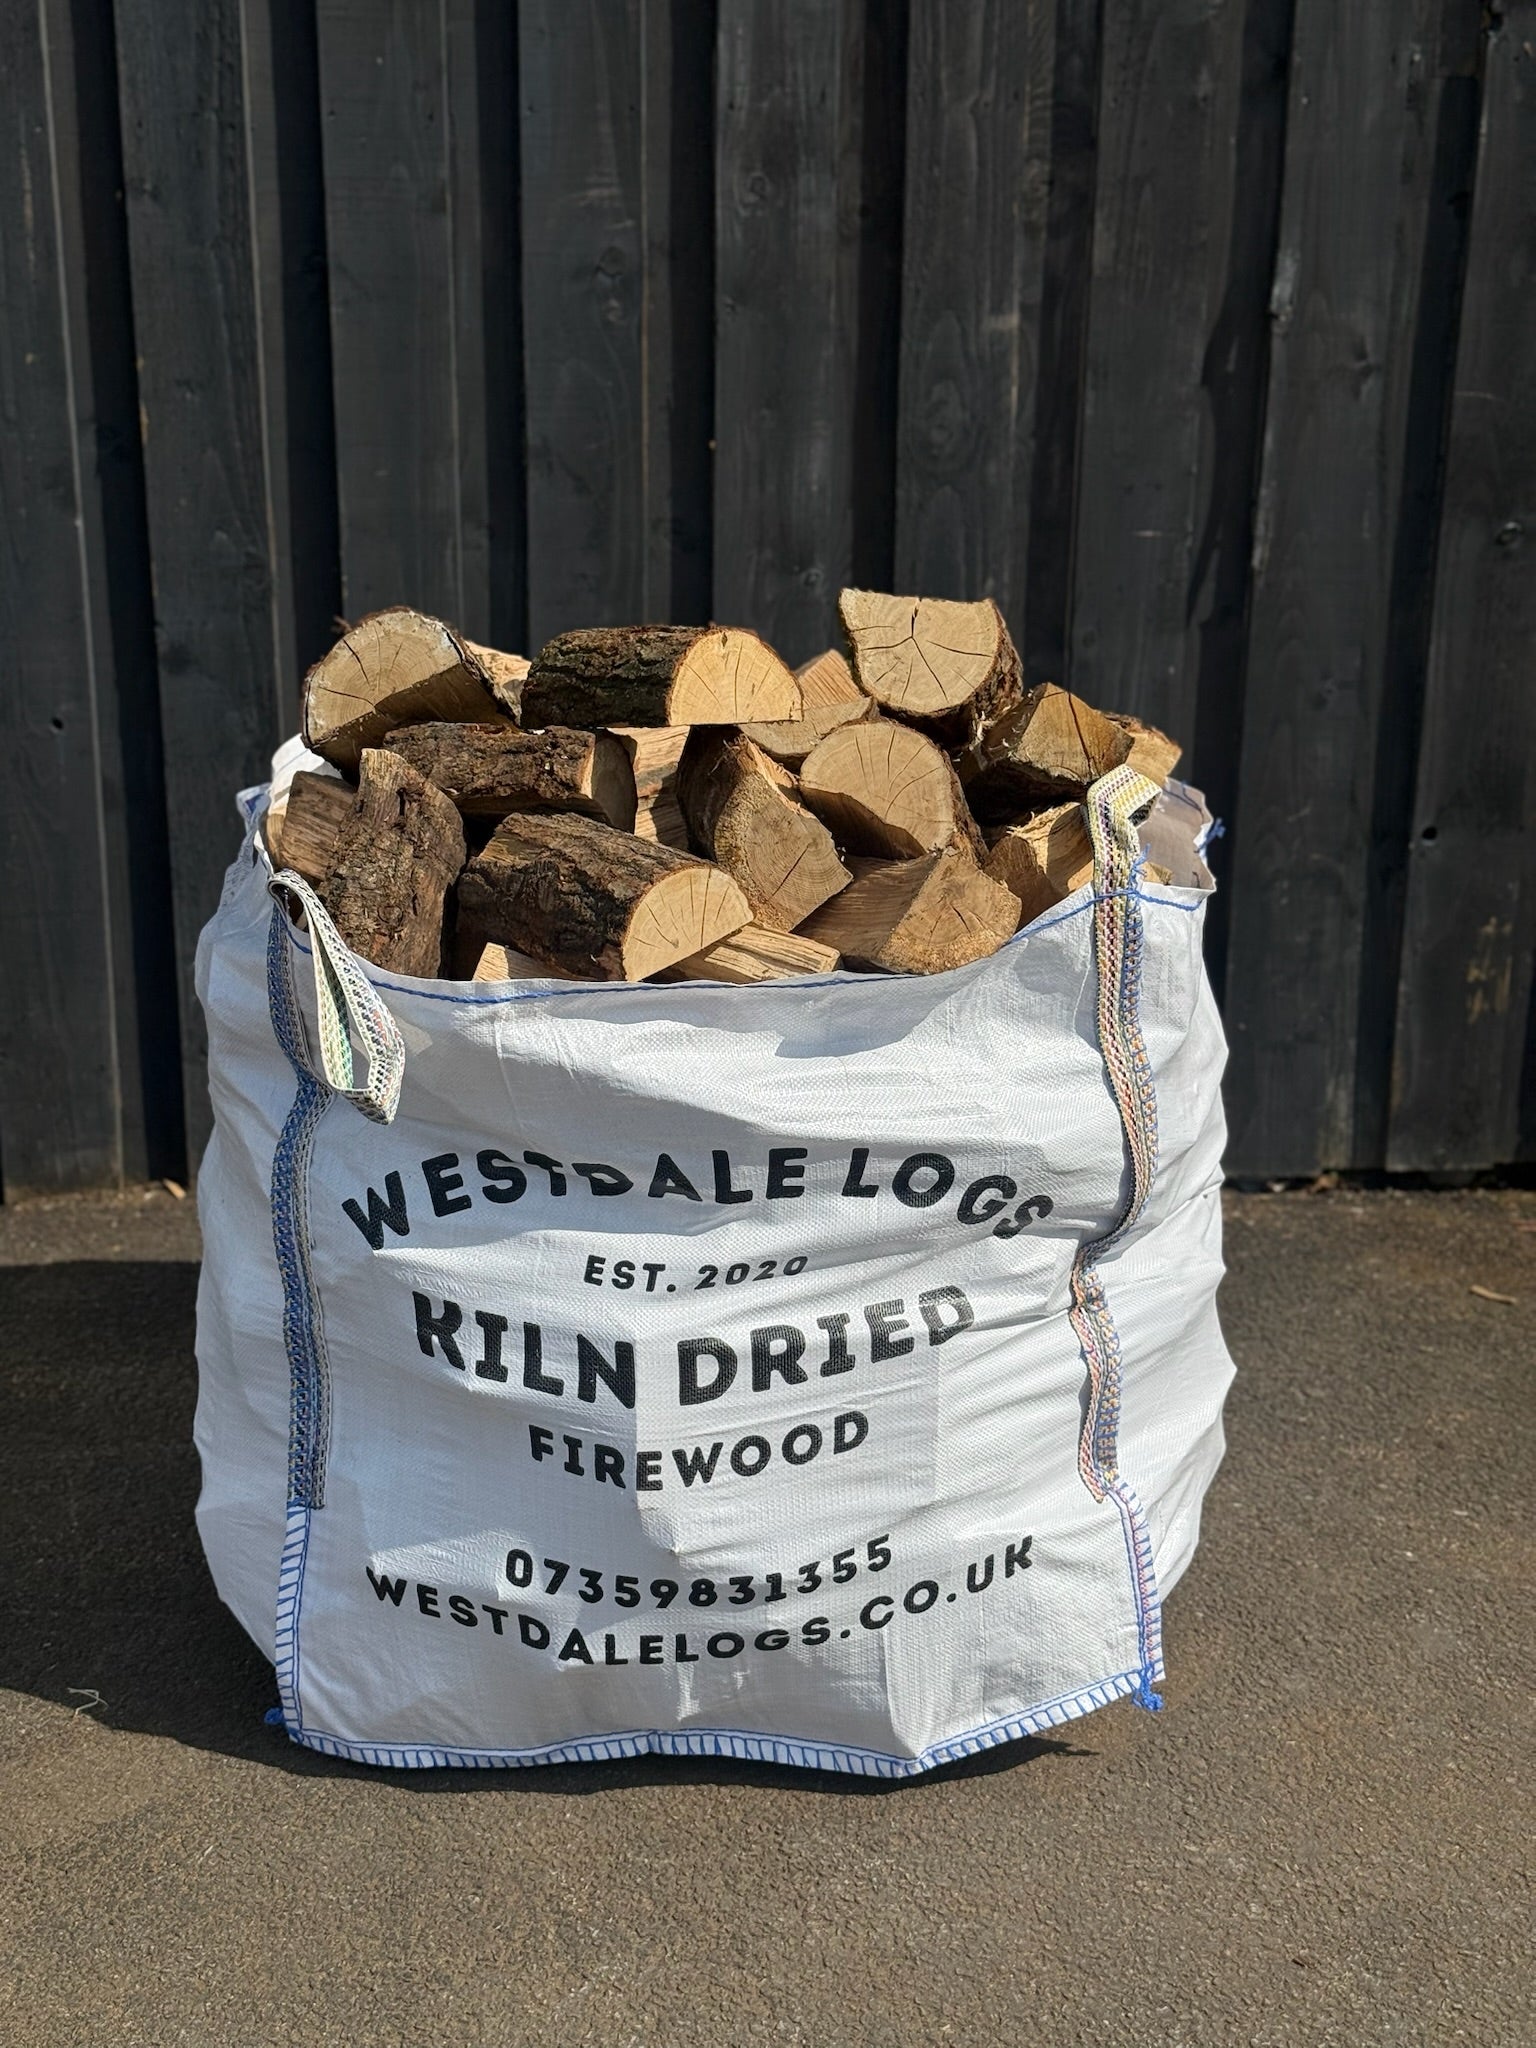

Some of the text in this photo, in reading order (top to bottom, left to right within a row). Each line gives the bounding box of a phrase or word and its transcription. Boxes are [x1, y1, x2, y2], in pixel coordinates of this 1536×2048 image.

[341, 1147, 1054, 1251] WESTDALE LOGS
[583, 1254, 809, 1293] EST. 2020
[411, 1285, 976, 1410] KILN DRIED
[528, 1409, 870, 1493] FIREWOOD
[366, 1534, 1034, 1665] WESTDALELOGS.CO.UK
[505, 1533, 893, 1609] 07359831355
